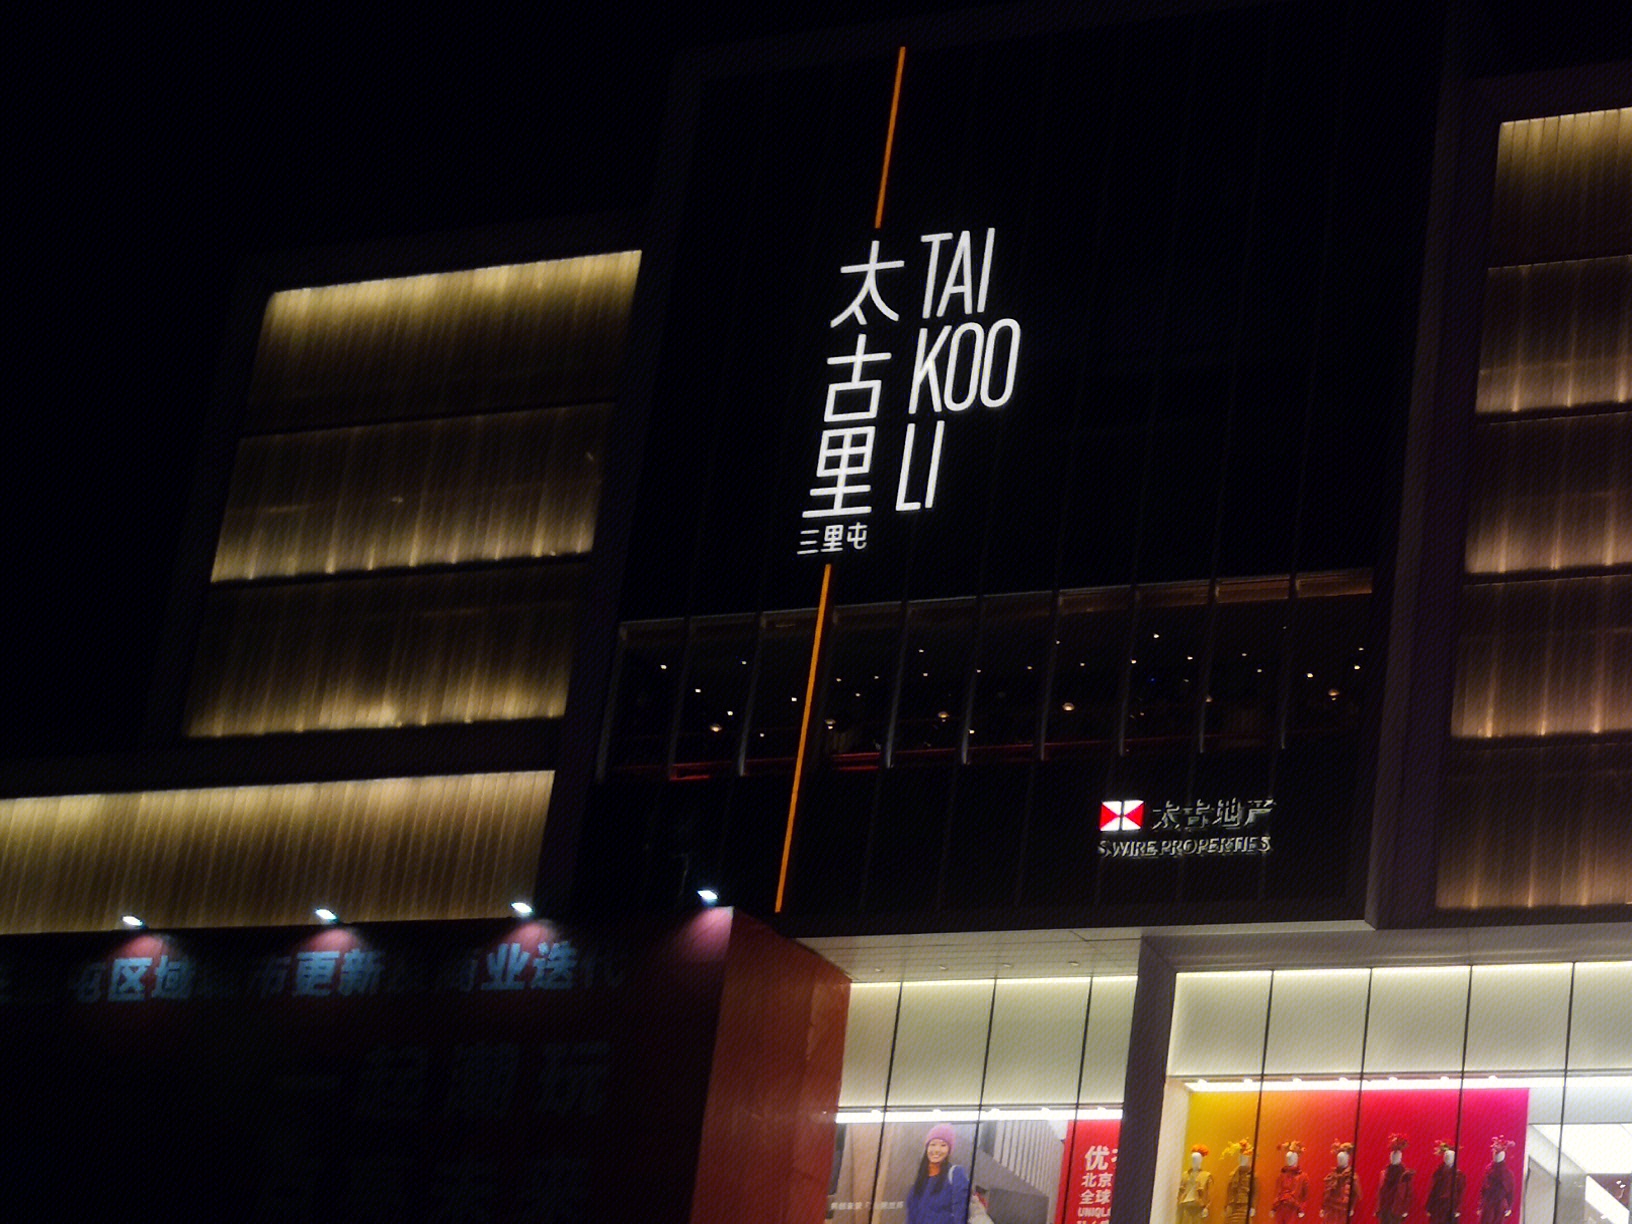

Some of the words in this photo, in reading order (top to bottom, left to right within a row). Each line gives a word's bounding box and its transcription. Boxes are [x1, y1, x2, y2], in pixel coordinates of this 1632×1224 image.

[919, 227, 996, 319] TAI
[800, 240, 906, 518] 太古里
[908, 318, 1021, 414] KOO
[895, 420, 945, 512] LI
[796, 522, 868, 555] 三里屯
[1152, 797, 1277, 831] 太古地产
